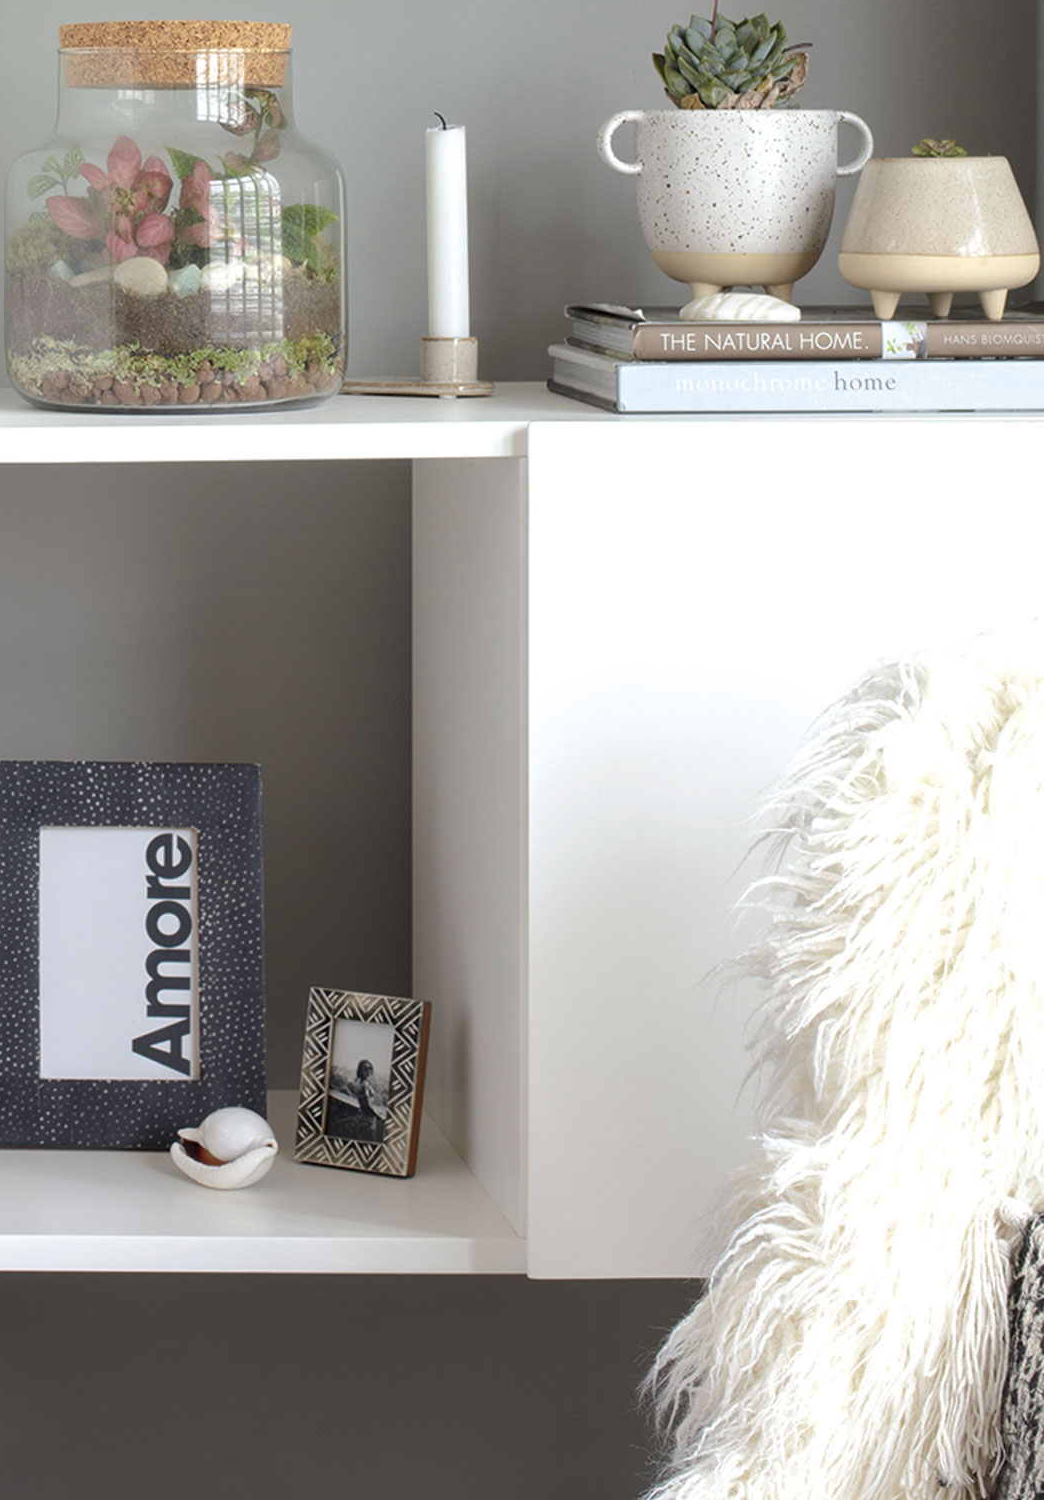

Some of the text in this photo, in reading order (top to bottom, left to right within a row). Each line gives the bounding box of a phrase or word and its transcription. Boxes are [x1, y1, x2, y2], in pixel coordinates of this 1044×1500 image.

[660, 331, 869, 351] THE NATURAL HOME.
[943, 334, 977, 345] HANS
[675, 371, 897, 393] monochrome home
[131, 833, 192, 1077] Amore
